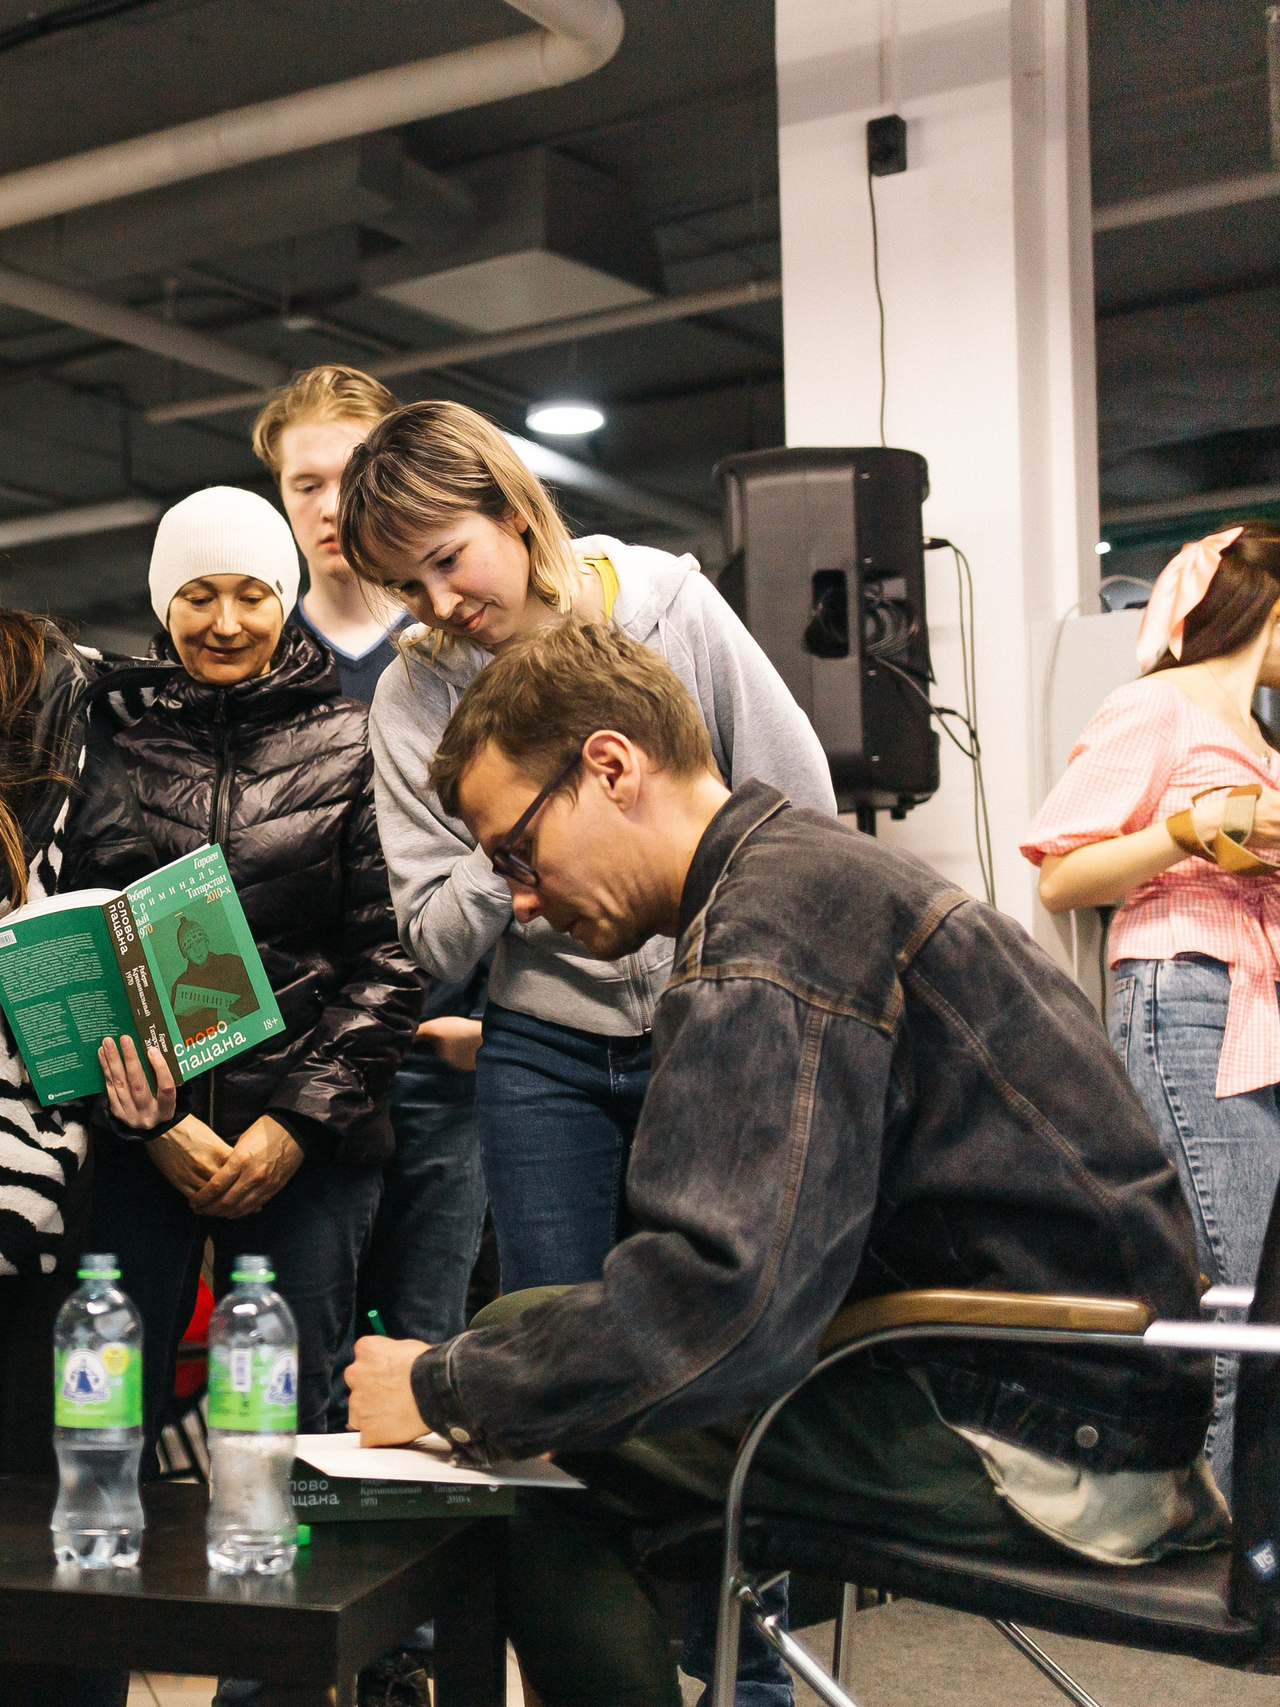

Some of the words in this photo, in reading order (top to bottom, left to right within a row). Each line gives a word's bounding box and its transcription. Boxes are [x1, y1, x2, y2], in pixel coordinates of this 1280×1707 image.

[193, 851, 219, 870] Гараев
[185, 874, 228, 899] Татарстан
[117, 900, 135, 942] слово
[138, 923, 153, 940] 970
[204, 885, 231, 904] 2010-х
[108, 904, 128, 956] пацана
[173, 1020, 228, 1057] слово
[262, 1017, 279, 1031] 18+
[178, 1031, 247, 1075] пацана
[292, 1480, 329, 1491] лово
[292, 1493, 340, 1506] цана
